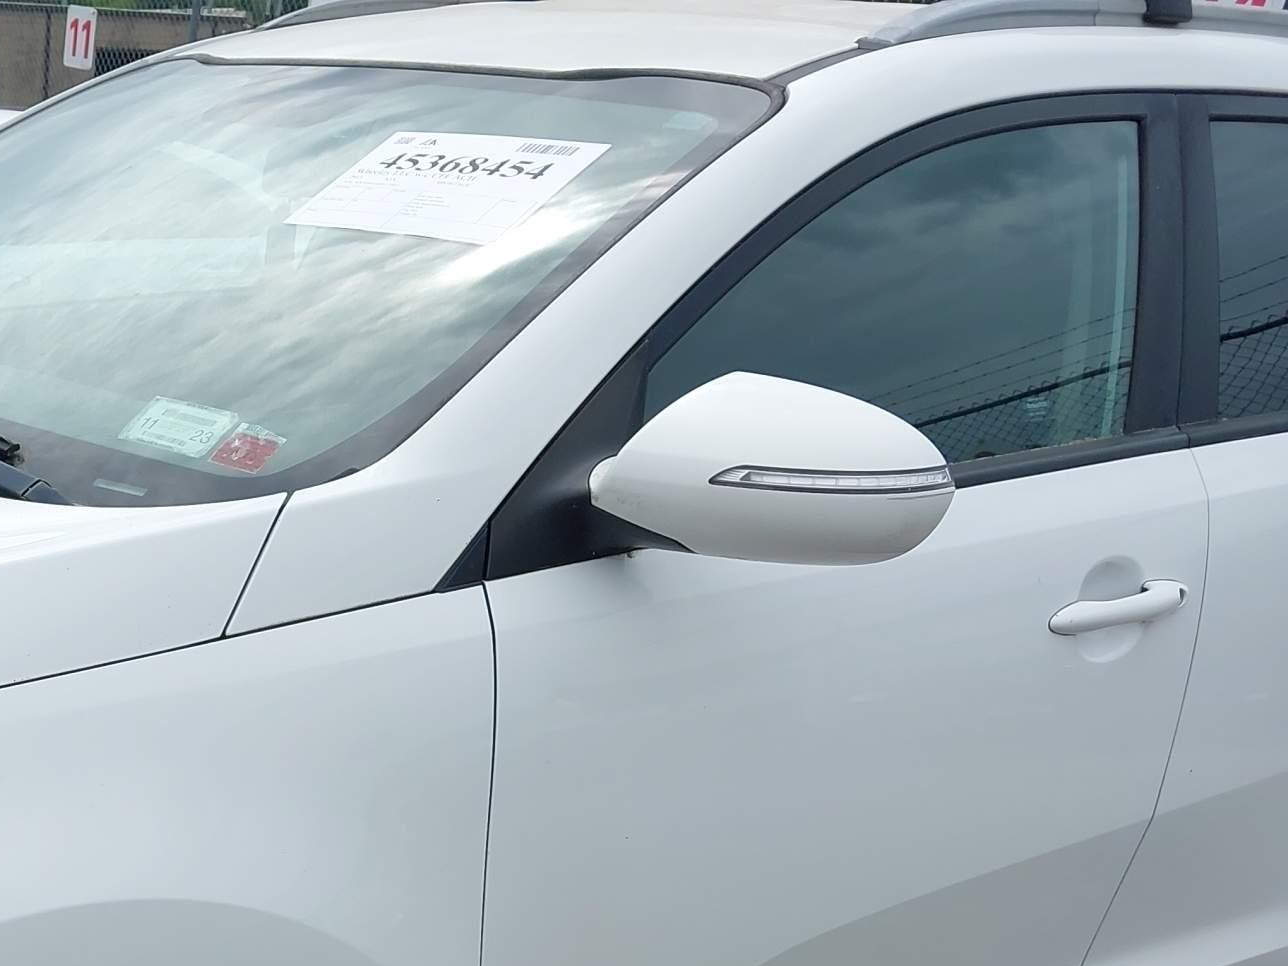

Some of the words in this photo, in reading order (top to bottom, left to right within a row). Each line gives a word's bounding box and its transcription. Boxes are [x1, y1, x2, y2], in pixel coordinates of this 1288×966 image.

[70, 17, 91, 59] 11
[379, 152, 555, 181] 45368454
[189, 429, 214, 445] 23
